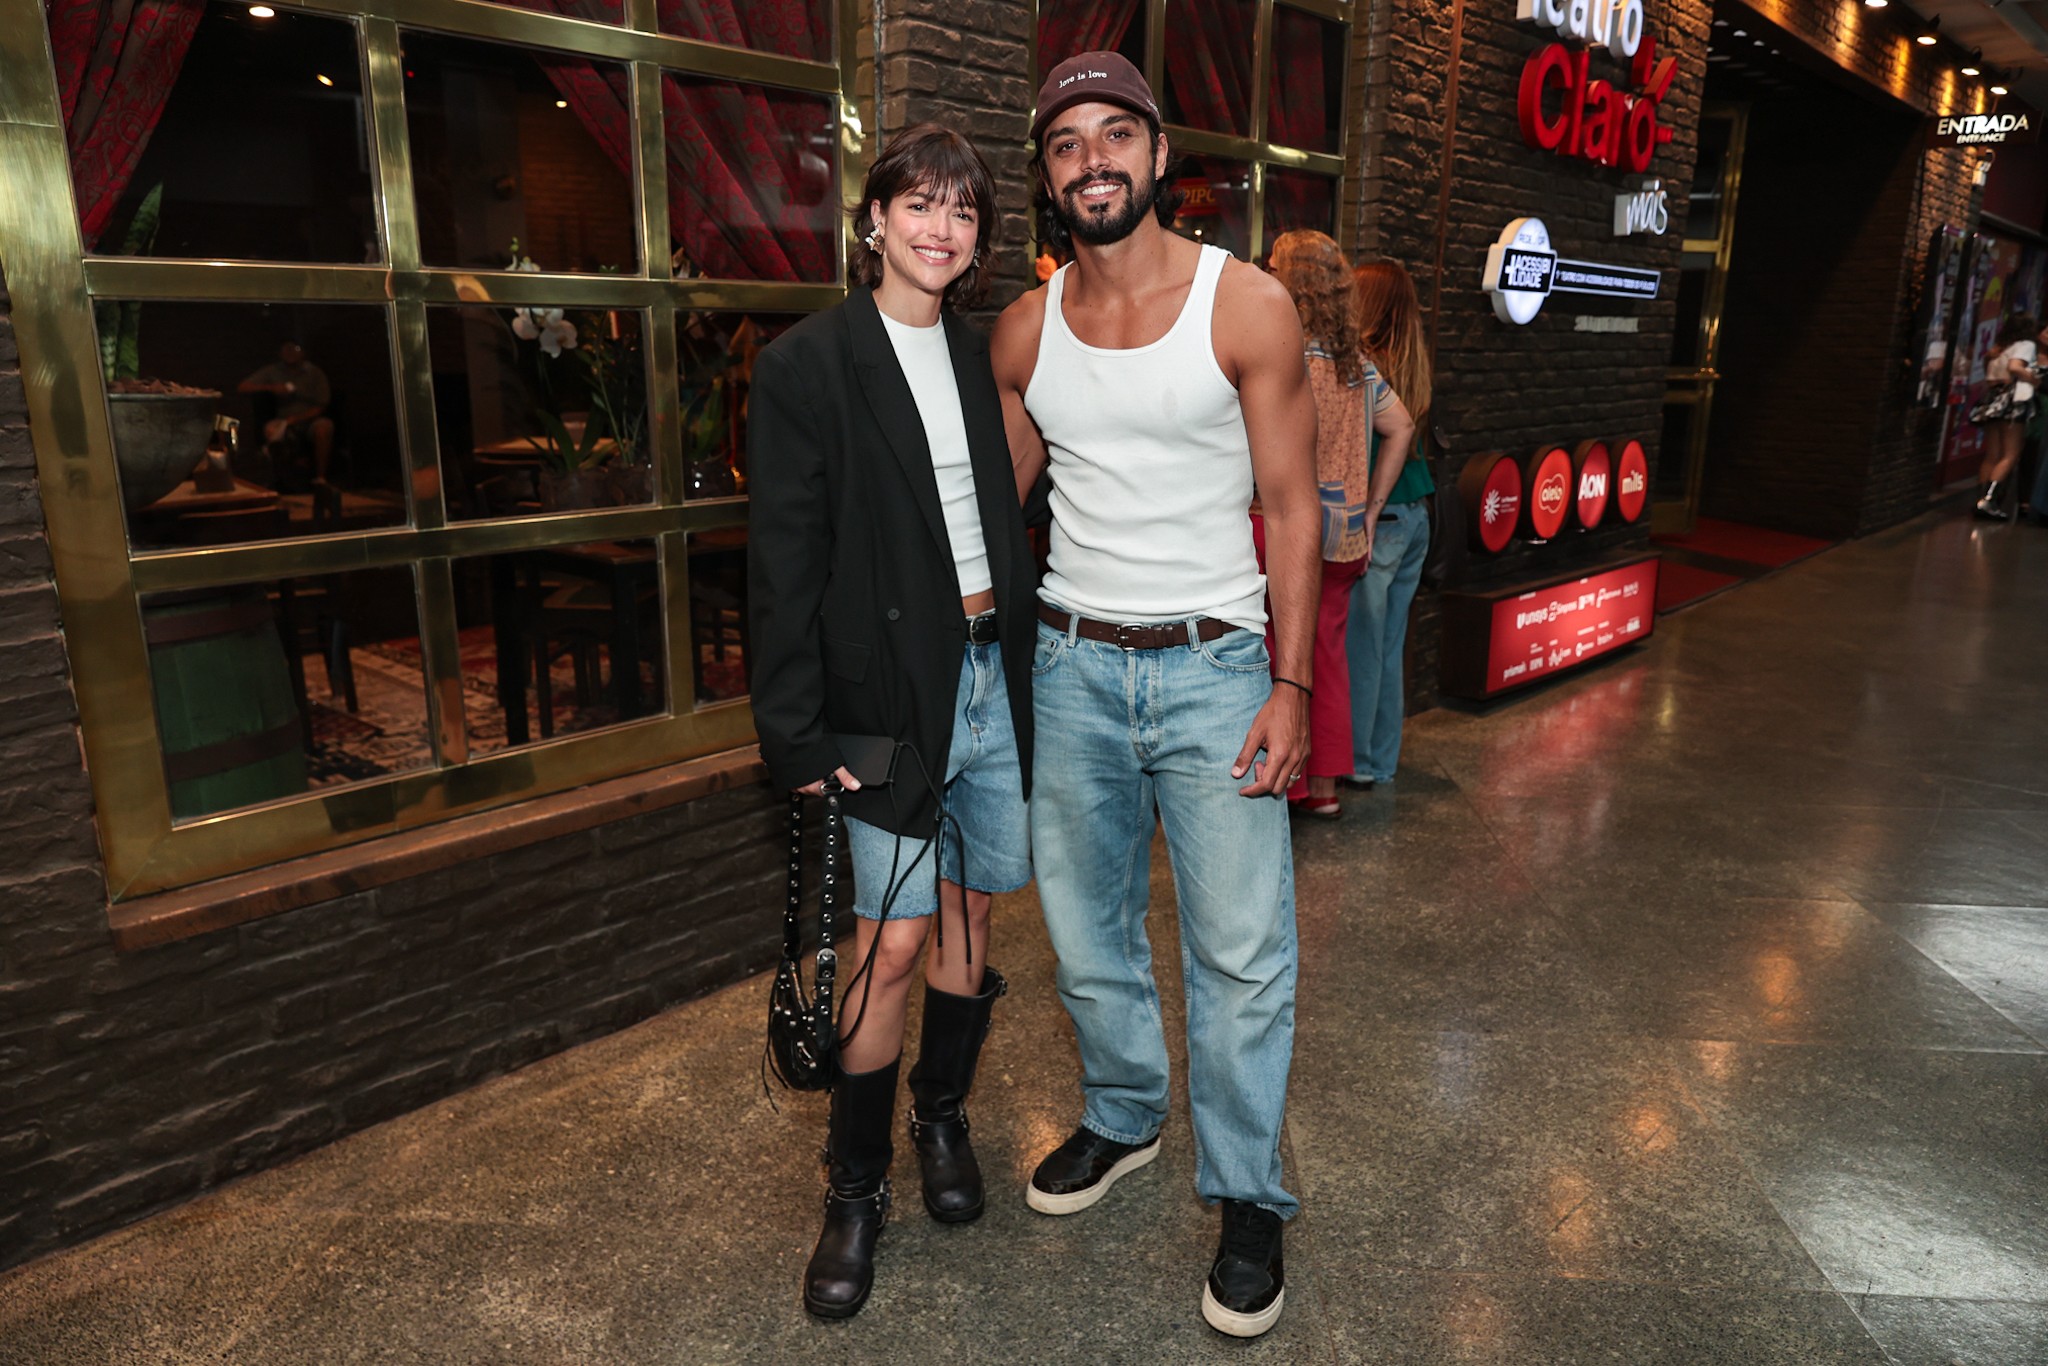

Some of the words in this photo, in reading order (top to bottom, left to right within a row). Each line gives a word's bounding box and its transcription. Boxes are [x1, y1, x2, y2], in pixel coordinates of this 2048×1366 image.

[1058, 76, 1075, 88] love
[1077, 72, 1086, 80] is
[1088, 70, 1107, 79] love
[1518, 43, 1656, 173] Claro
[1937, 114, 2029, 135] ENTRADA
[1956, 133, 2006, 144] ENTRANCE
[1578, 473, 1606, 500] AON
